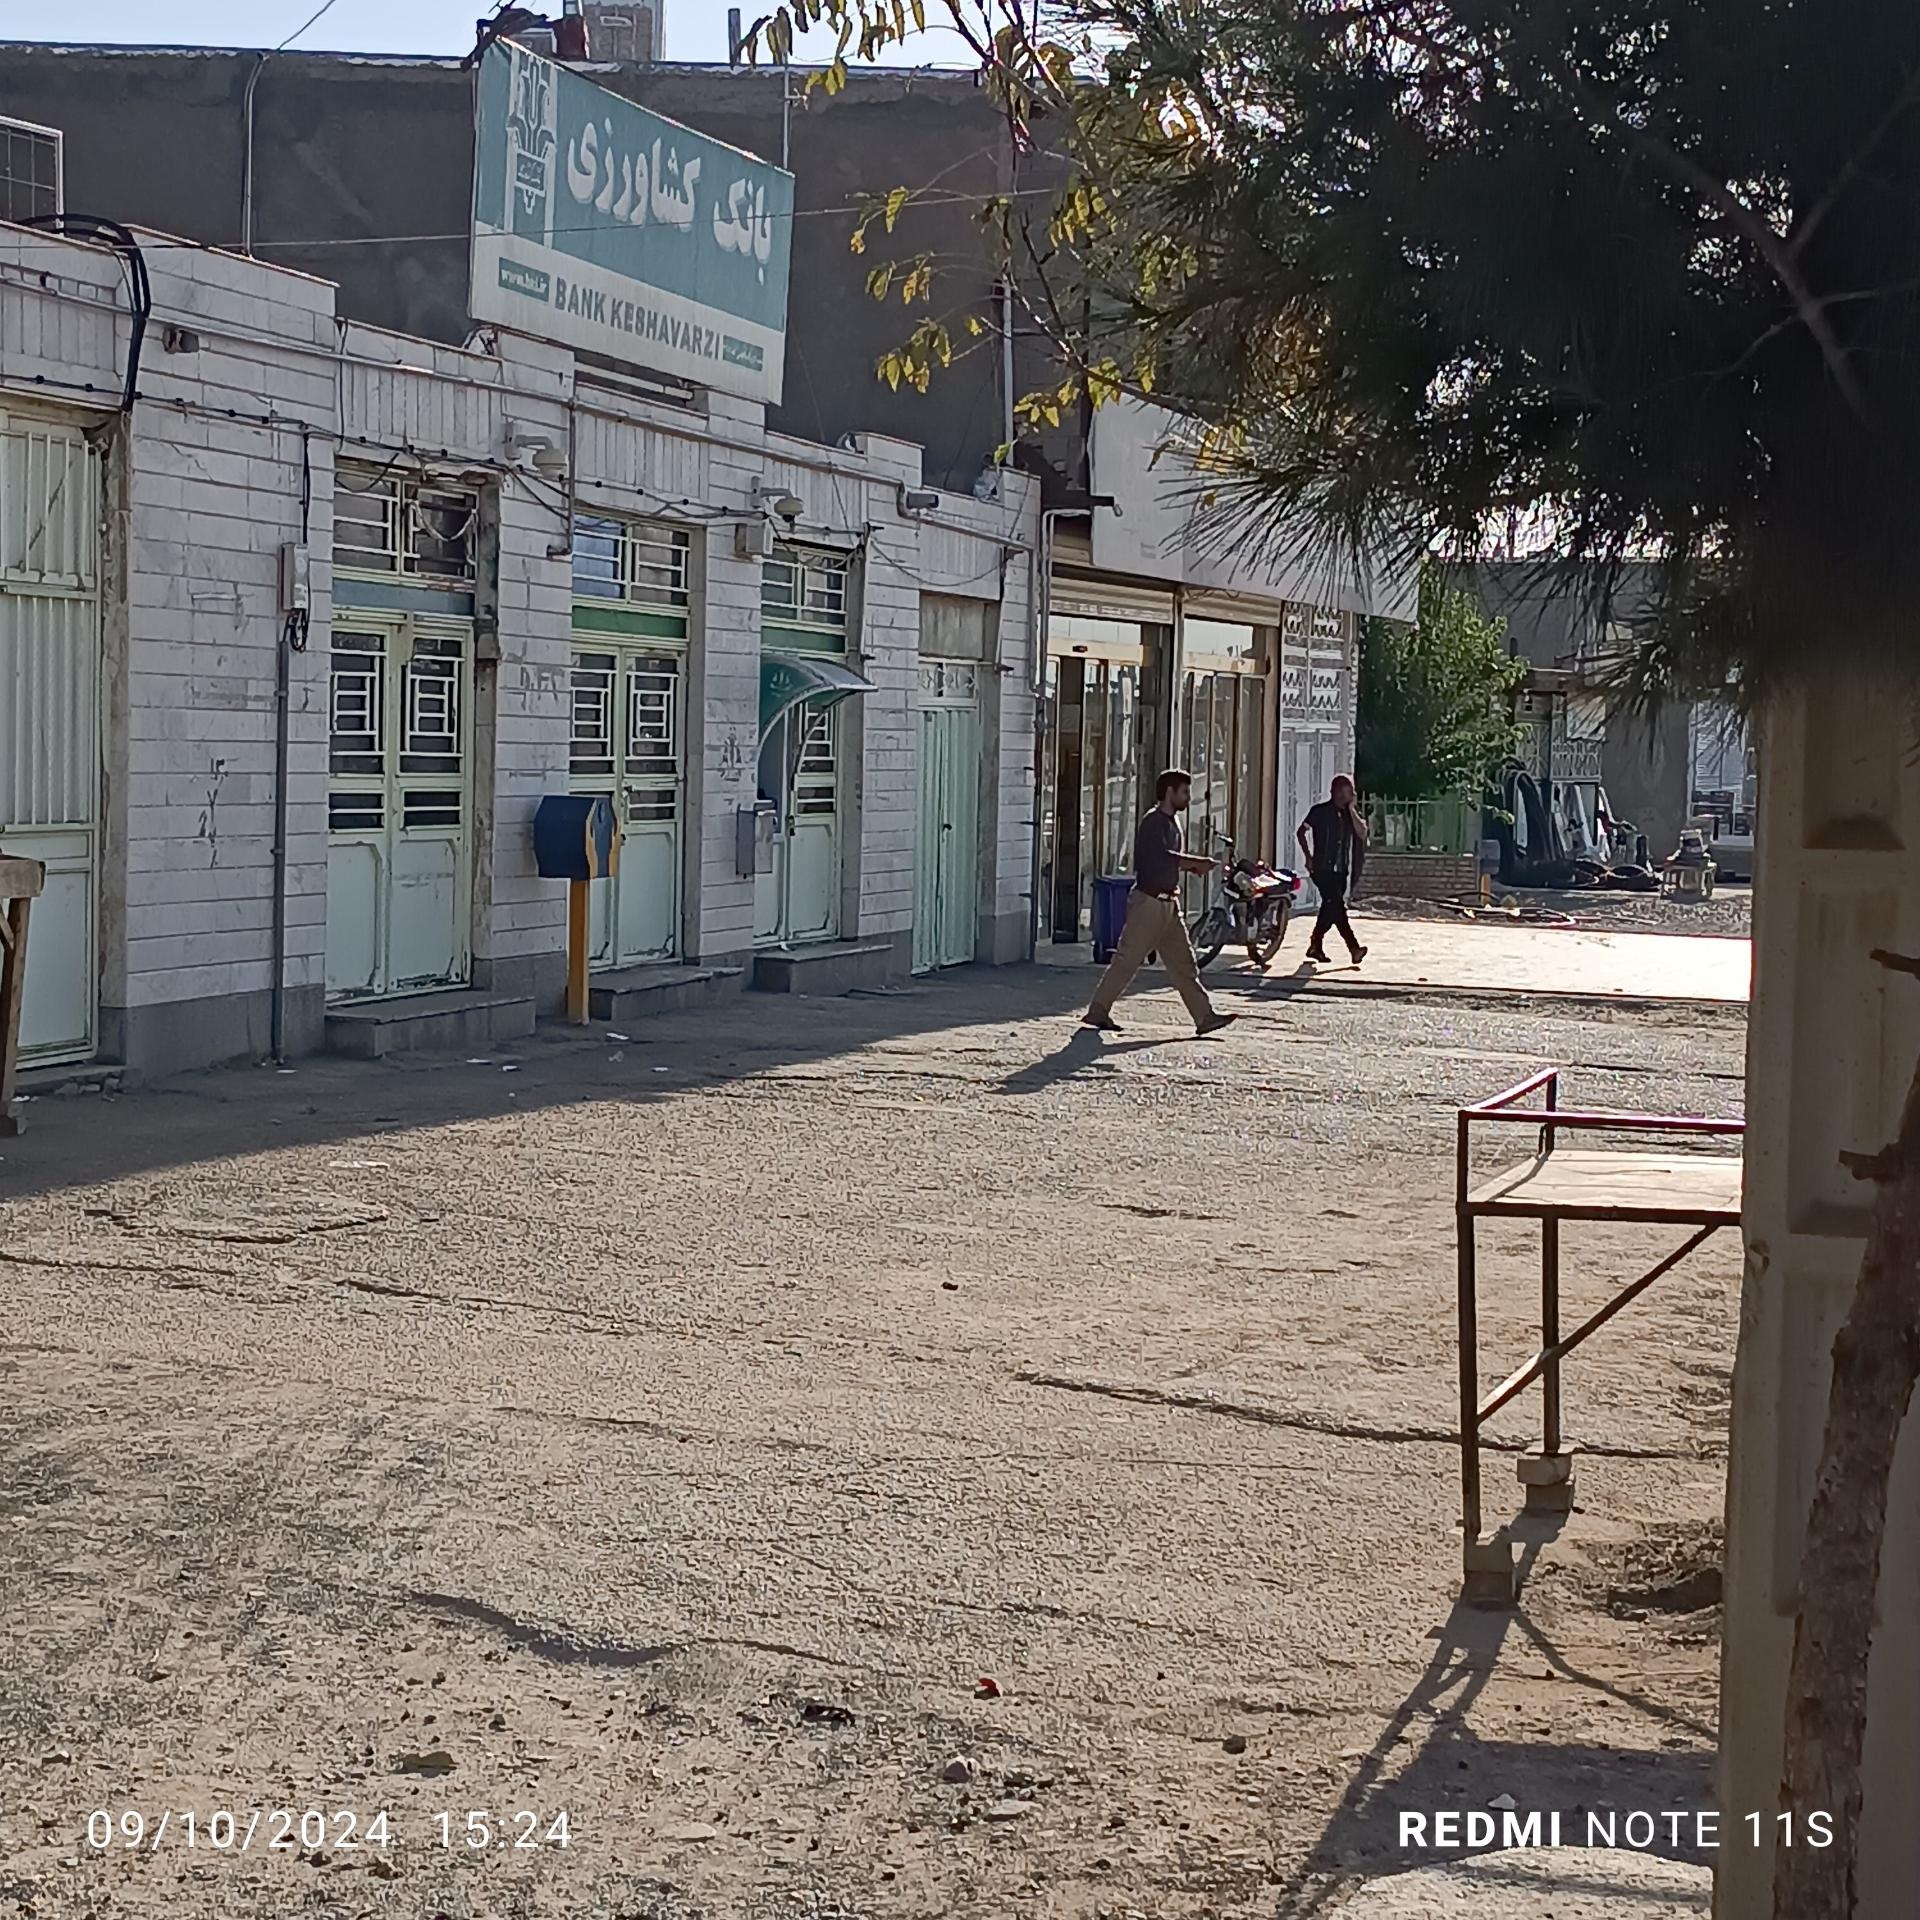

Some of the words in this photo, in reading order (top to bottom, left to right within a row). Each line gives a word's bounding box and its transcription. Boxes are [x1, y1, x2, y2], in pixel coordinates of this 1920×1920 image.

[568, 116, 701, 233] کشاورزی
[714, 177, 772, 287] بانک
[555, 276, 607, 324] BANK
[610, 297, 720, 361] KESHAVARZI
